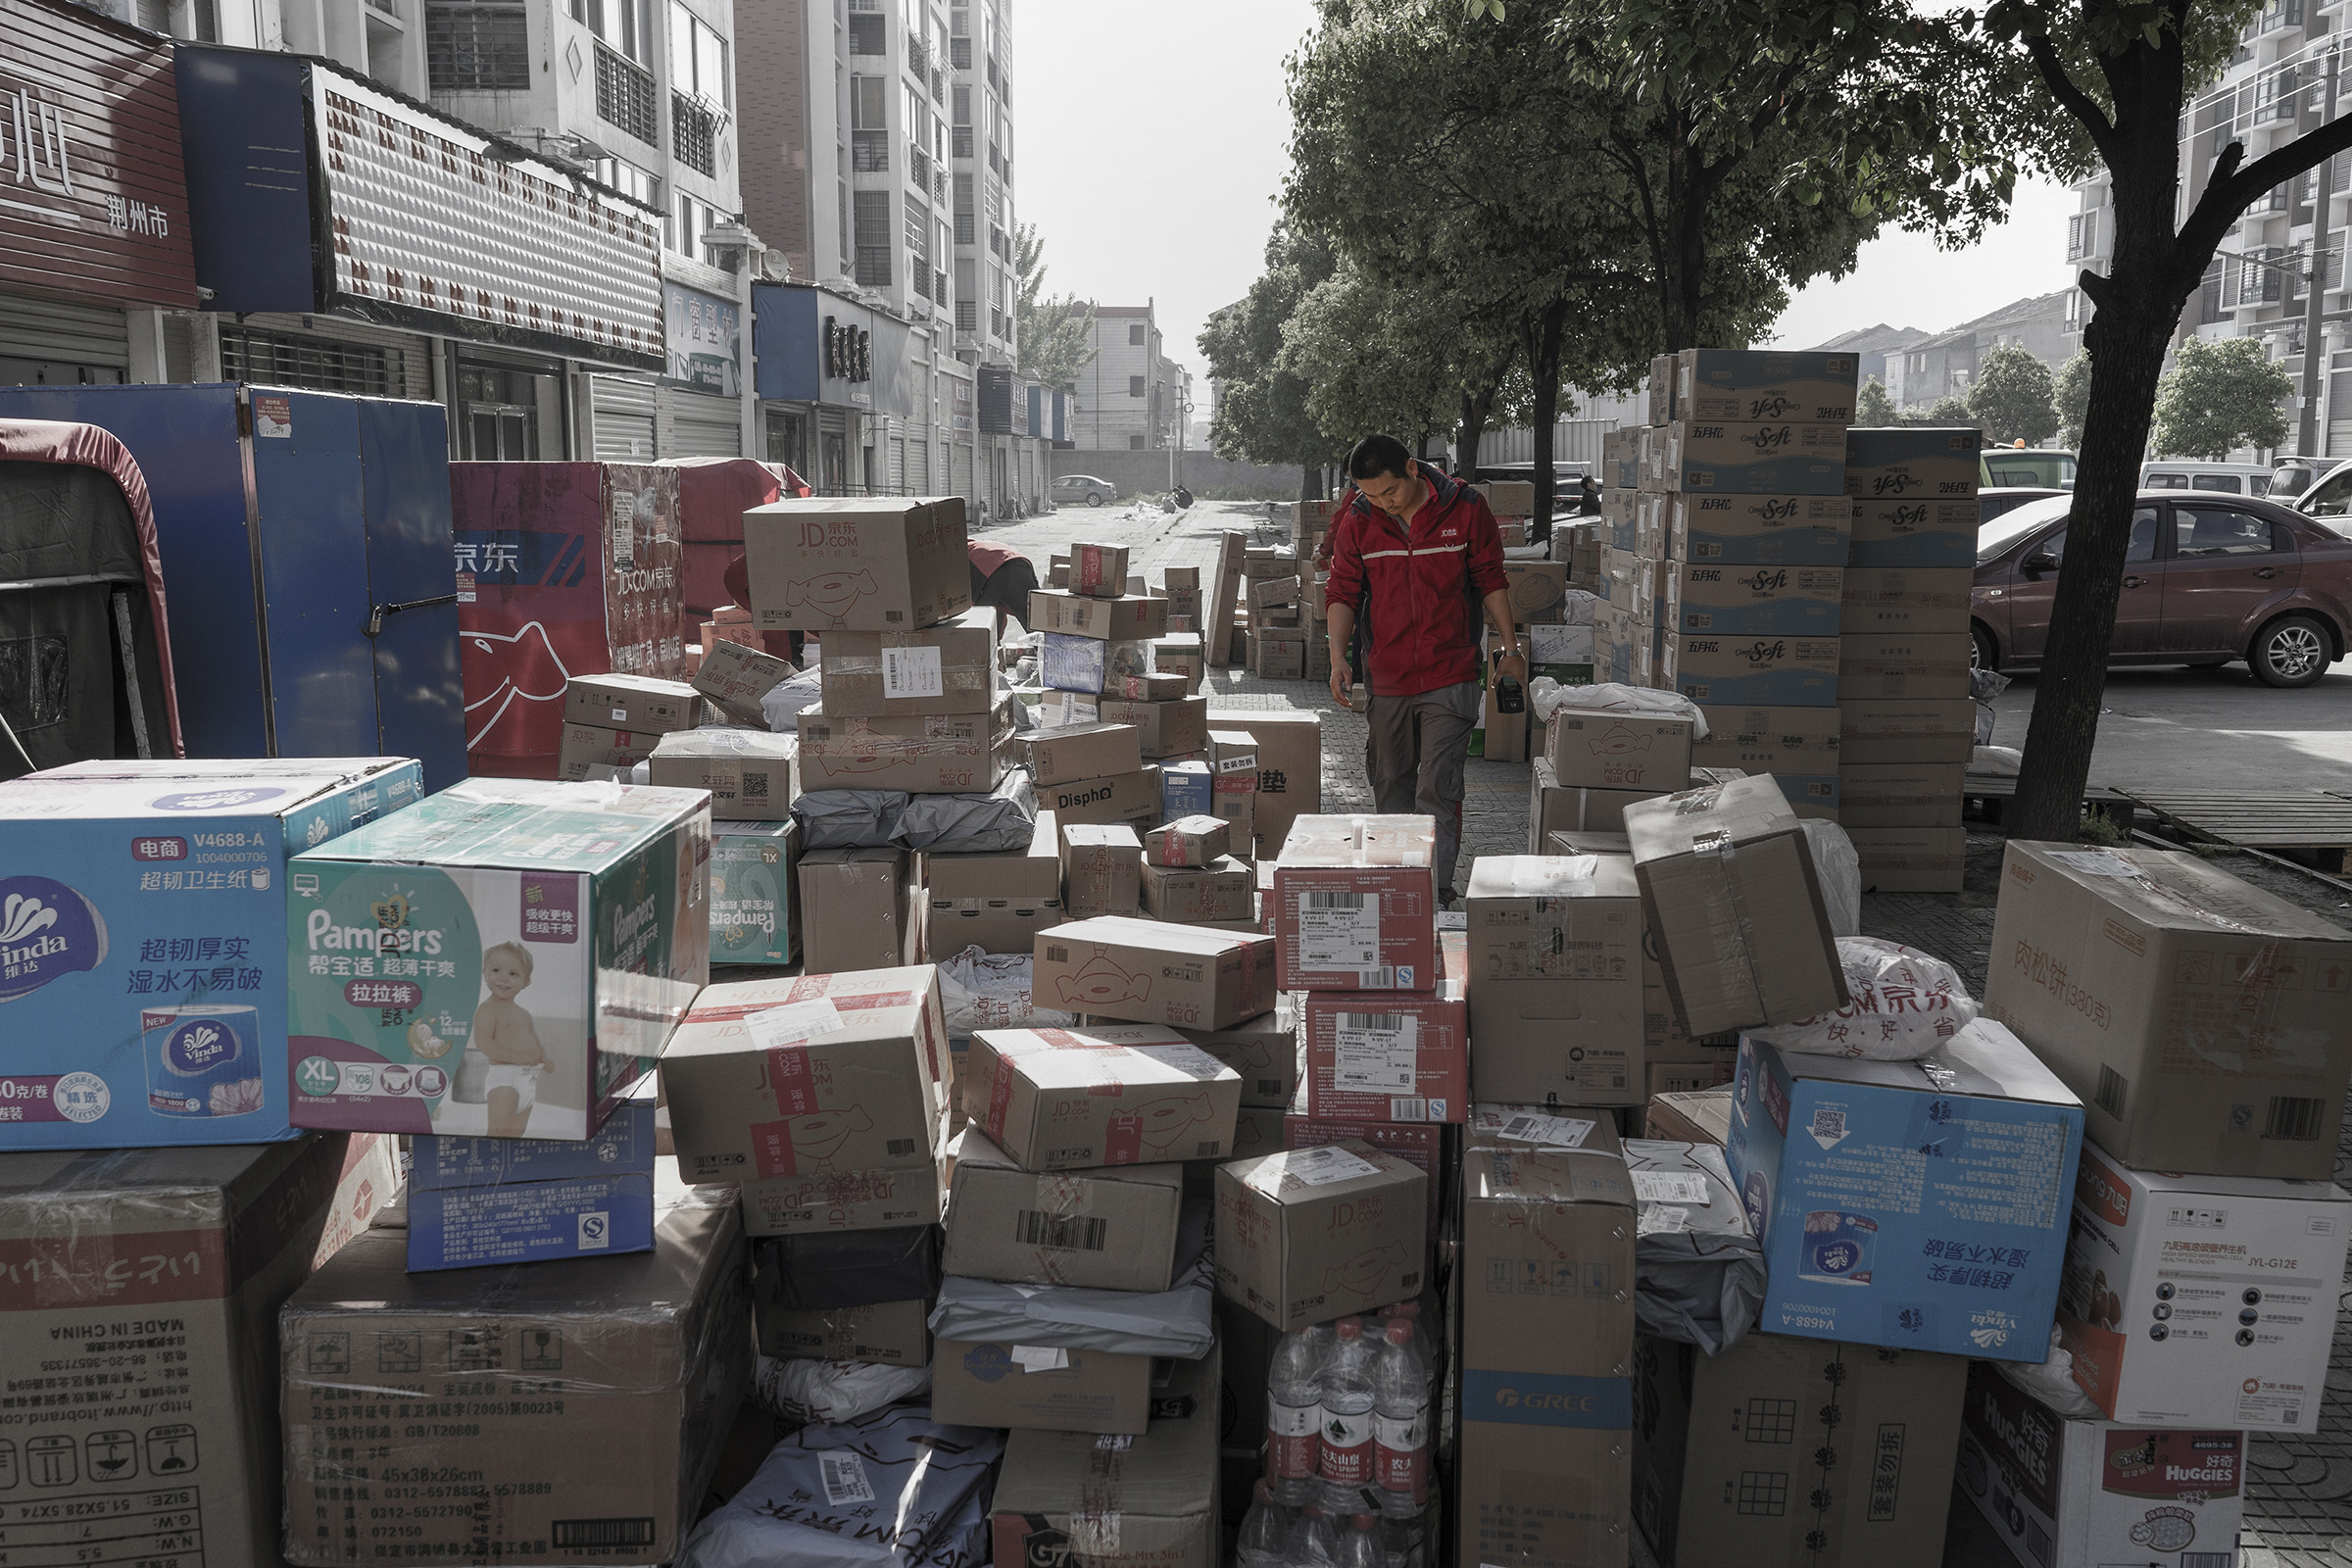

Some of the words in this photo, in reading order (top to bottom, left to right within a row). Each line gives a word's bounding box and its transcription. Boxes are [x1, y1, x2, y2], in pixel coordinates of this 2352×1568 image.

[106, 194, 169, 239] 荆州市
[671, 291, 734, 351] 门窗型材
[1749, 398, 1786, 418] Soft
[1816, 407, 1848, 419] 五月花
[1691, 426, 1725, 438] 五月花
[1755, 426, 1792, 448] Soft
[1873, 474, 1910, 495] Soft
[1938, 481, 1971, 493] 五月花
[1699, 498, 1733, 511] 五月花
[1762, 498, 1799, 519] Soft
[1892, 504, 1929, 524] Soft
[827, 521, 857, 534] 京东
[454, 542, 519, 573] 京东
[1690, 569, 1723, 582] 五月花
[1751, 569, 1788, 591] Soft
[1687, 641, 1720, 653] 五月花
[1748, 640, 1787, 662] Soft
[1223, 758, 1253, 770] 套装勿拆
[701, 774, 735, 785] 文轩网
[139, 840, 179, 858] 电商
[193, 833, 266, 848] V4688-A
[195, 852, 268, 863] 1004000706
[762, 852, 777, 863] XL
[139, 869, 249, 891] 超韧卫生纸
[524, 885, 544, 904] 新
[525, 907, 574, 922] 吸收更快
[307, 908, 443, 957] Pampers
[525, 921, 574, 935] 超级干爽
[139, 936, 251, 963] 超韧厚实
[1508, 941, 1527, 951] 九阳
[4, 960, 39, 979] 维达
[308, 955, 376, 976] 帮宝适
[382, 957, 456, 978] 超薄干爽
[125, 968, 265, 995] 湿水不易破
[2014, 938, 2111, 1031] 肉松饼(380克)
[352, 983, 413, 1004] 拉拉裤
[146, 1015, 167, 1028] NEW
[184, 1043, 224, 1061] Vinda
[304, 1059, 335, 1081] XL
[354, 1073, 370, 1085] 108
[66, 1091, 99, 1105] 精选
[1357, 1196, 1383, 1210] 京东
[2107, 1186, 2128, 1217] 九阳
[1923, 1238, 2032, 1268] 湿水不易破
[104, 1251, 201, 1290] いとう
[2248, 1256, 2298, 1269] JYL-G12E
[1927, 1262, 2015, 1291] 超韧厚实
[49, 1323, 107, 1340] CHINA
[111, 1322, 127, 1337] IN
[132, 1318, 184, 1335] MADE
[1782, 1314, 1835, 1330] V4688-A
[1970, 1313, 2016, 1330] Vinda
[40, 1353, 147, 1371] 86-20-36571335
[964, 1359, 1012, 1371] Goodfarmer
[1524, 1393, 1597, 1412] GREE
[368, 1446, 390, 1461] 3年
[2206, 1455, 2234, 1468] 好奇
[1872, 1431, 1901, 1516] 套装勿拆
[2165, 1464, 2233, 1481] HUGGIES
[494, 1483, 552, 1496] 5578889
[21, 1498, 131, 1519] 51.5X28.5X74
[146, 1492, 190, 1506] SIZE:
[83, 1526, 92, 1538] 7
[371, 1525, 422, 1539] 072150
[77, 1546, 103, 1560] 5.5
[1135, 1550, 1156, 1560] Mix
